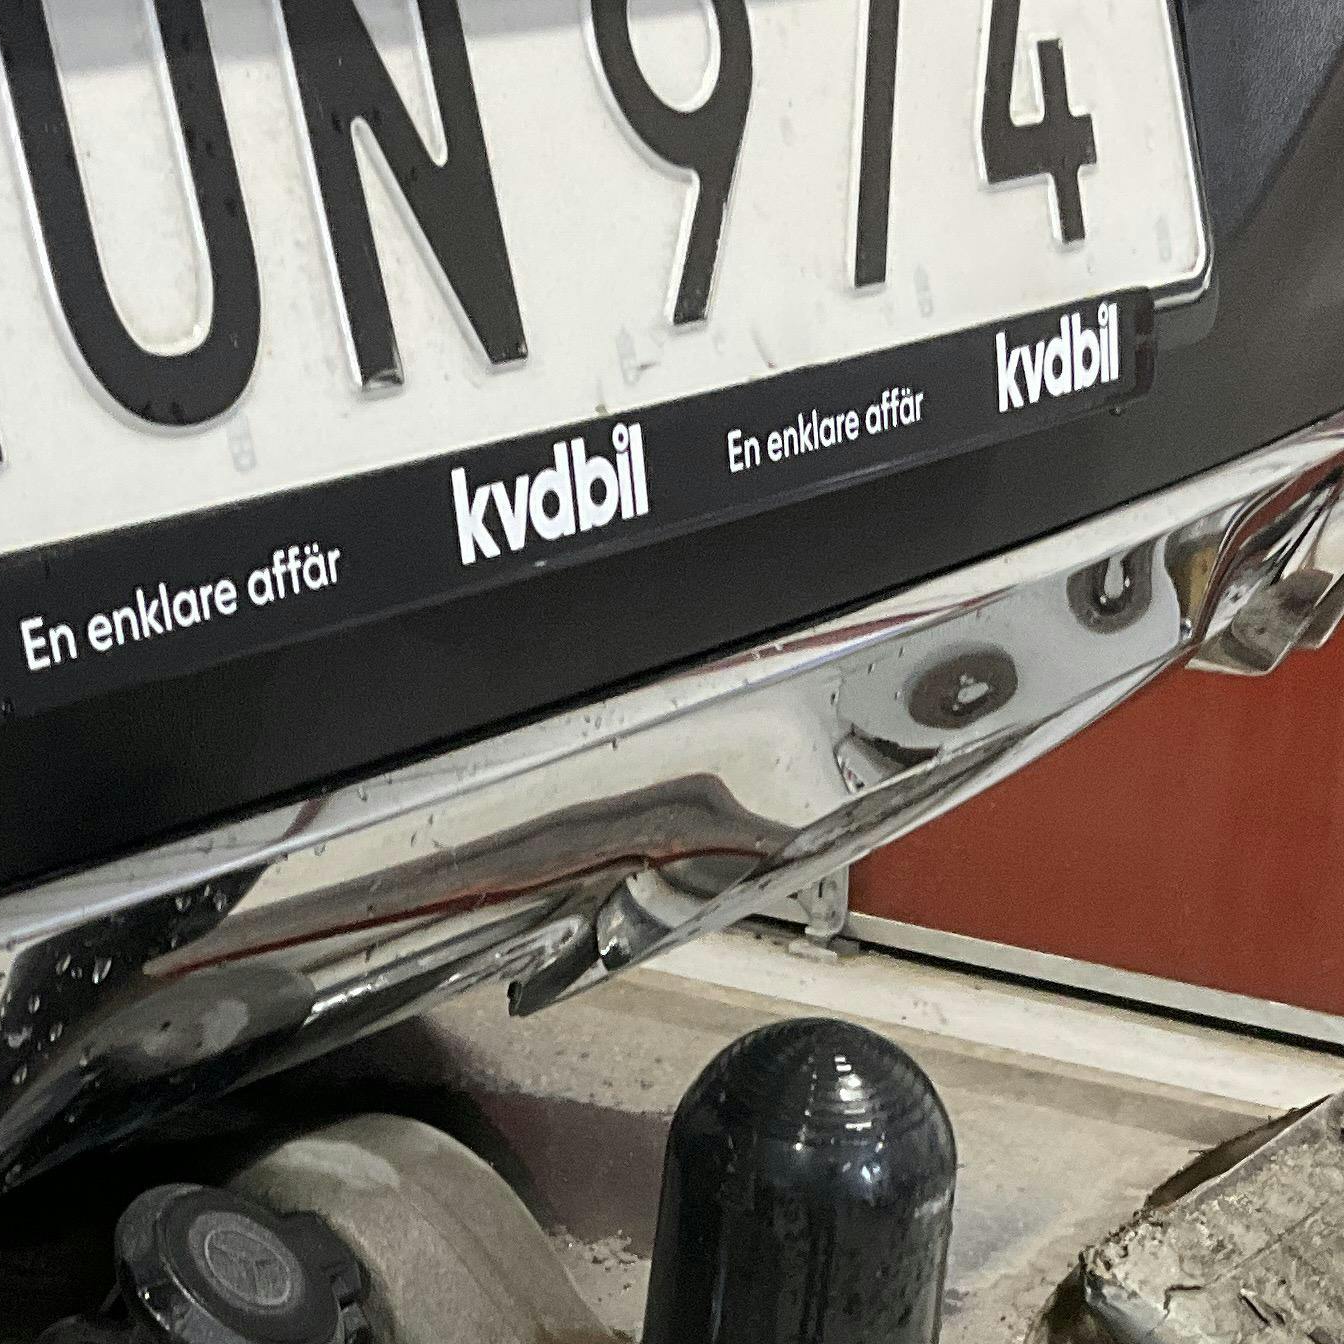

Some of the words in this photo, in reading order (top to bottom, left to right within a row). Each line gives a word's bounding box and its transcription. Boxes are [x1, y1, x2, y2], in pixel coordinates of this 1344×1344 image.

[20, 616, 77, 671] En
[87, 582, 238, 651] enklare
[247, 542, 341, 606] affär
[451, 422, 649, 565] kvdbil
[727, 428, 761, 473] En
[767, 408, 860, 462] enklare
[865, 387, 924, 435] affär
[995, 301, 1119, 413] kvdbil
